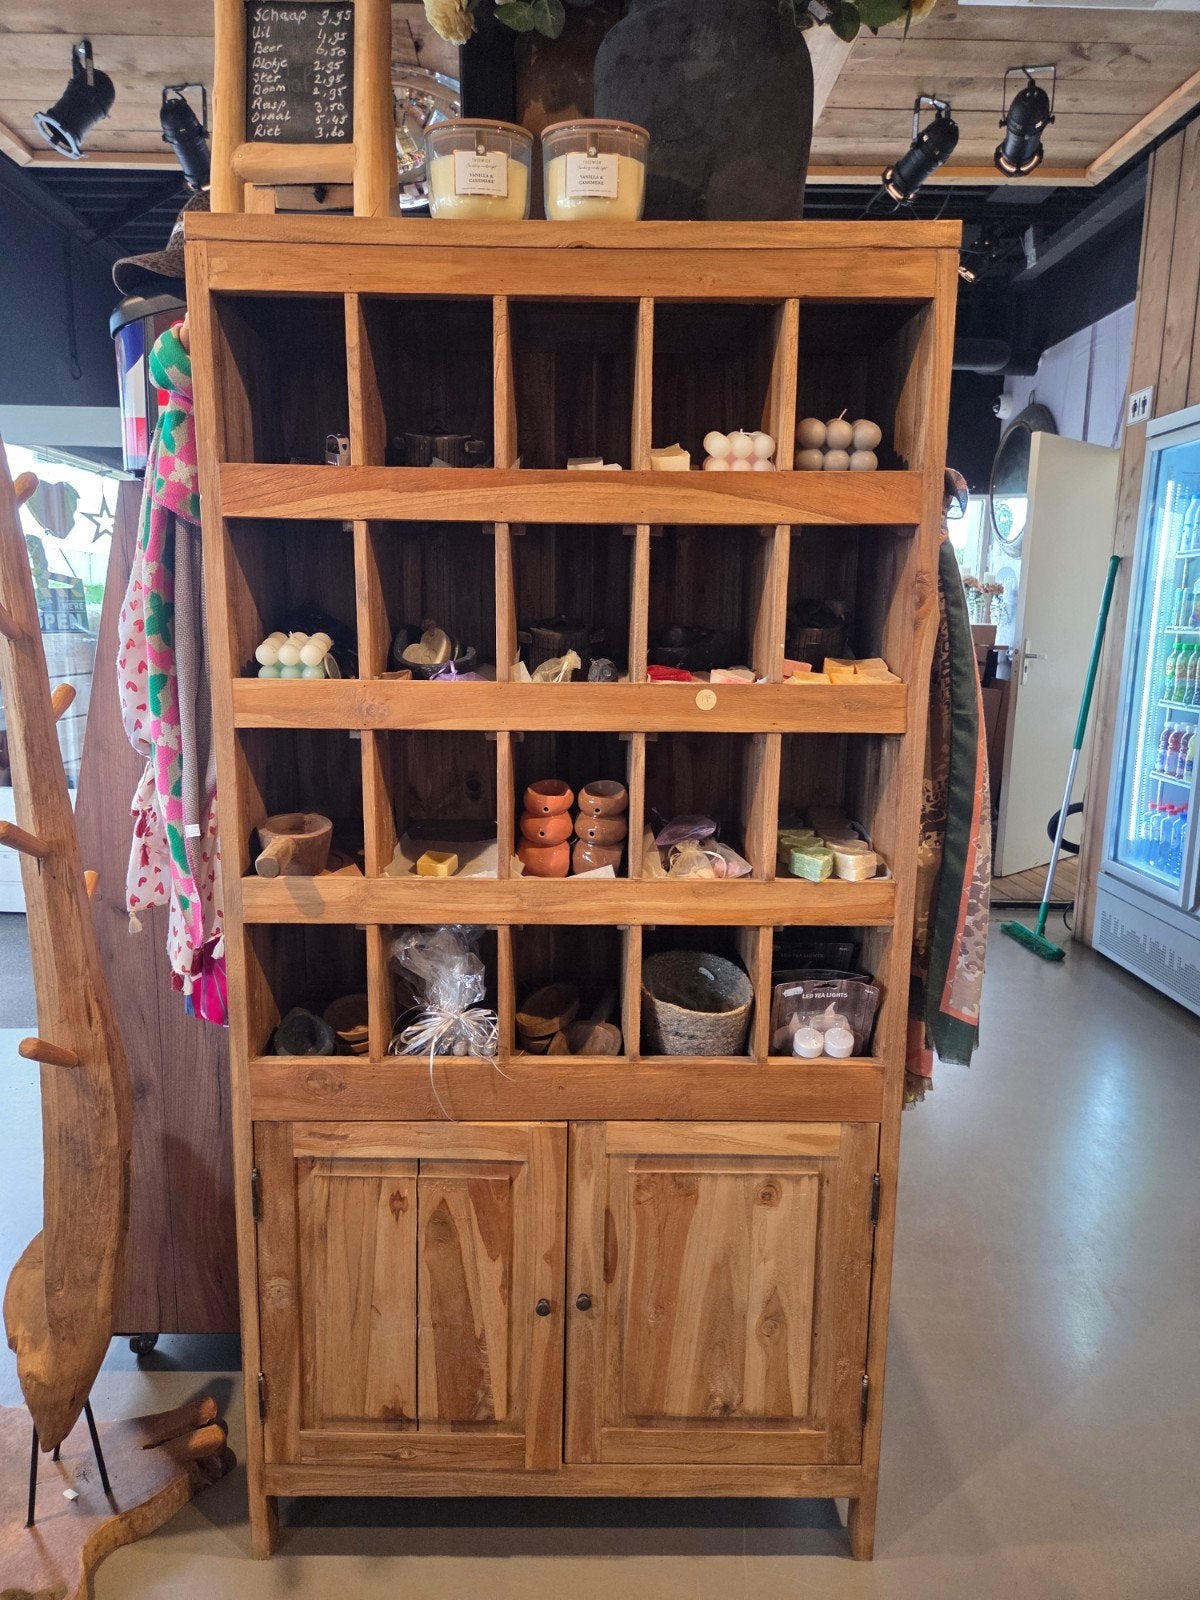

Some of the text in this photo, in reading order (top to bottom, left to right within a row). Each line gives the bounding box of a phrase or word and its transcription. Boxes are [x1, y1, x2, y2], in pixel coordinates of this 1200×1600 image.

[252, 26, 347, 45] Uil 4,95
[253, 41, 347, 56] Beer 6,50
[313, 60, 344, 74] 2,95
[253, 73, 345, 87] Ster 2,95
[253, 84, 347, 101] Boom 2,95
[251, 97, 345, 113] Rasp 3,50
[254, 124, 345, 138] Riet 3,60
